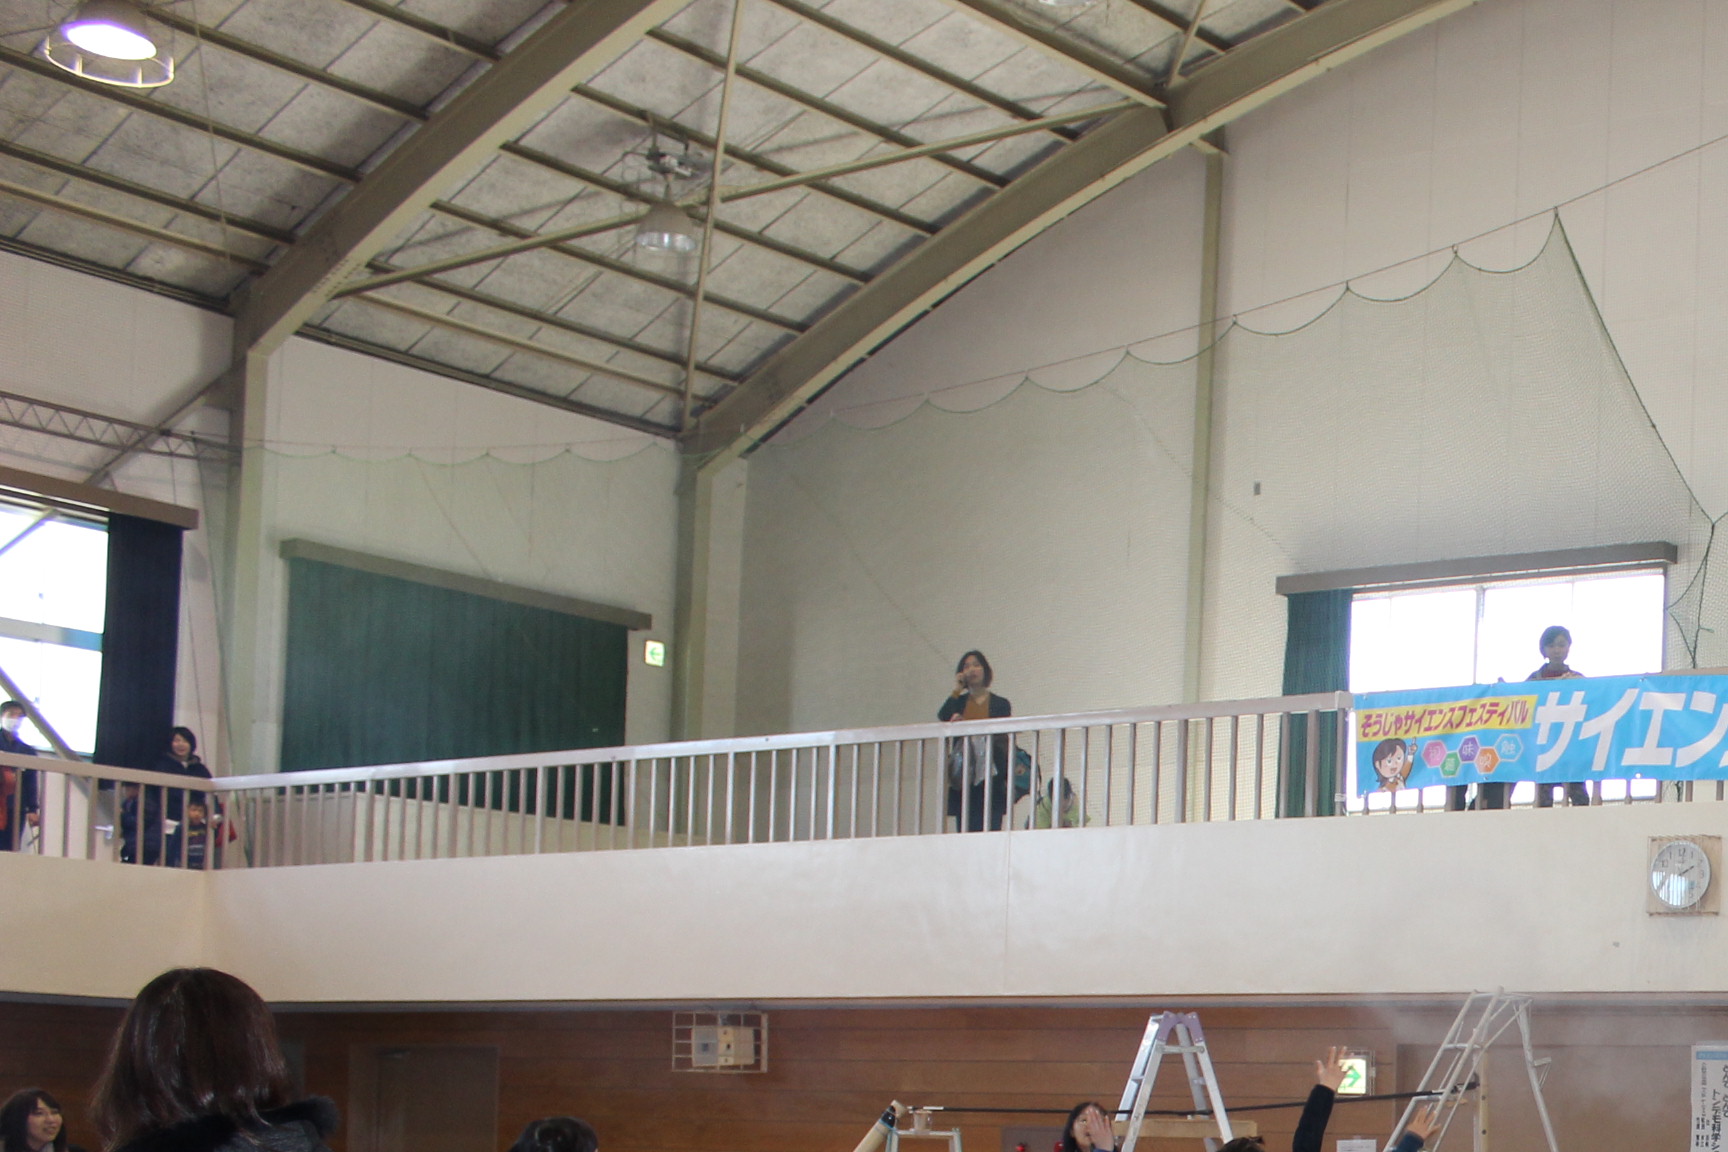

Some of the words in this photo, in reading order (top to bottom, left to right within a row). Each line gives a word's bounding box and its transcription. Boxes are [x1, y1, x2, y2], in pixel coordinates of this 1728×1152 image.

[1361, 700, 1529, 738] そうじゃサイエンスフェスティバル
